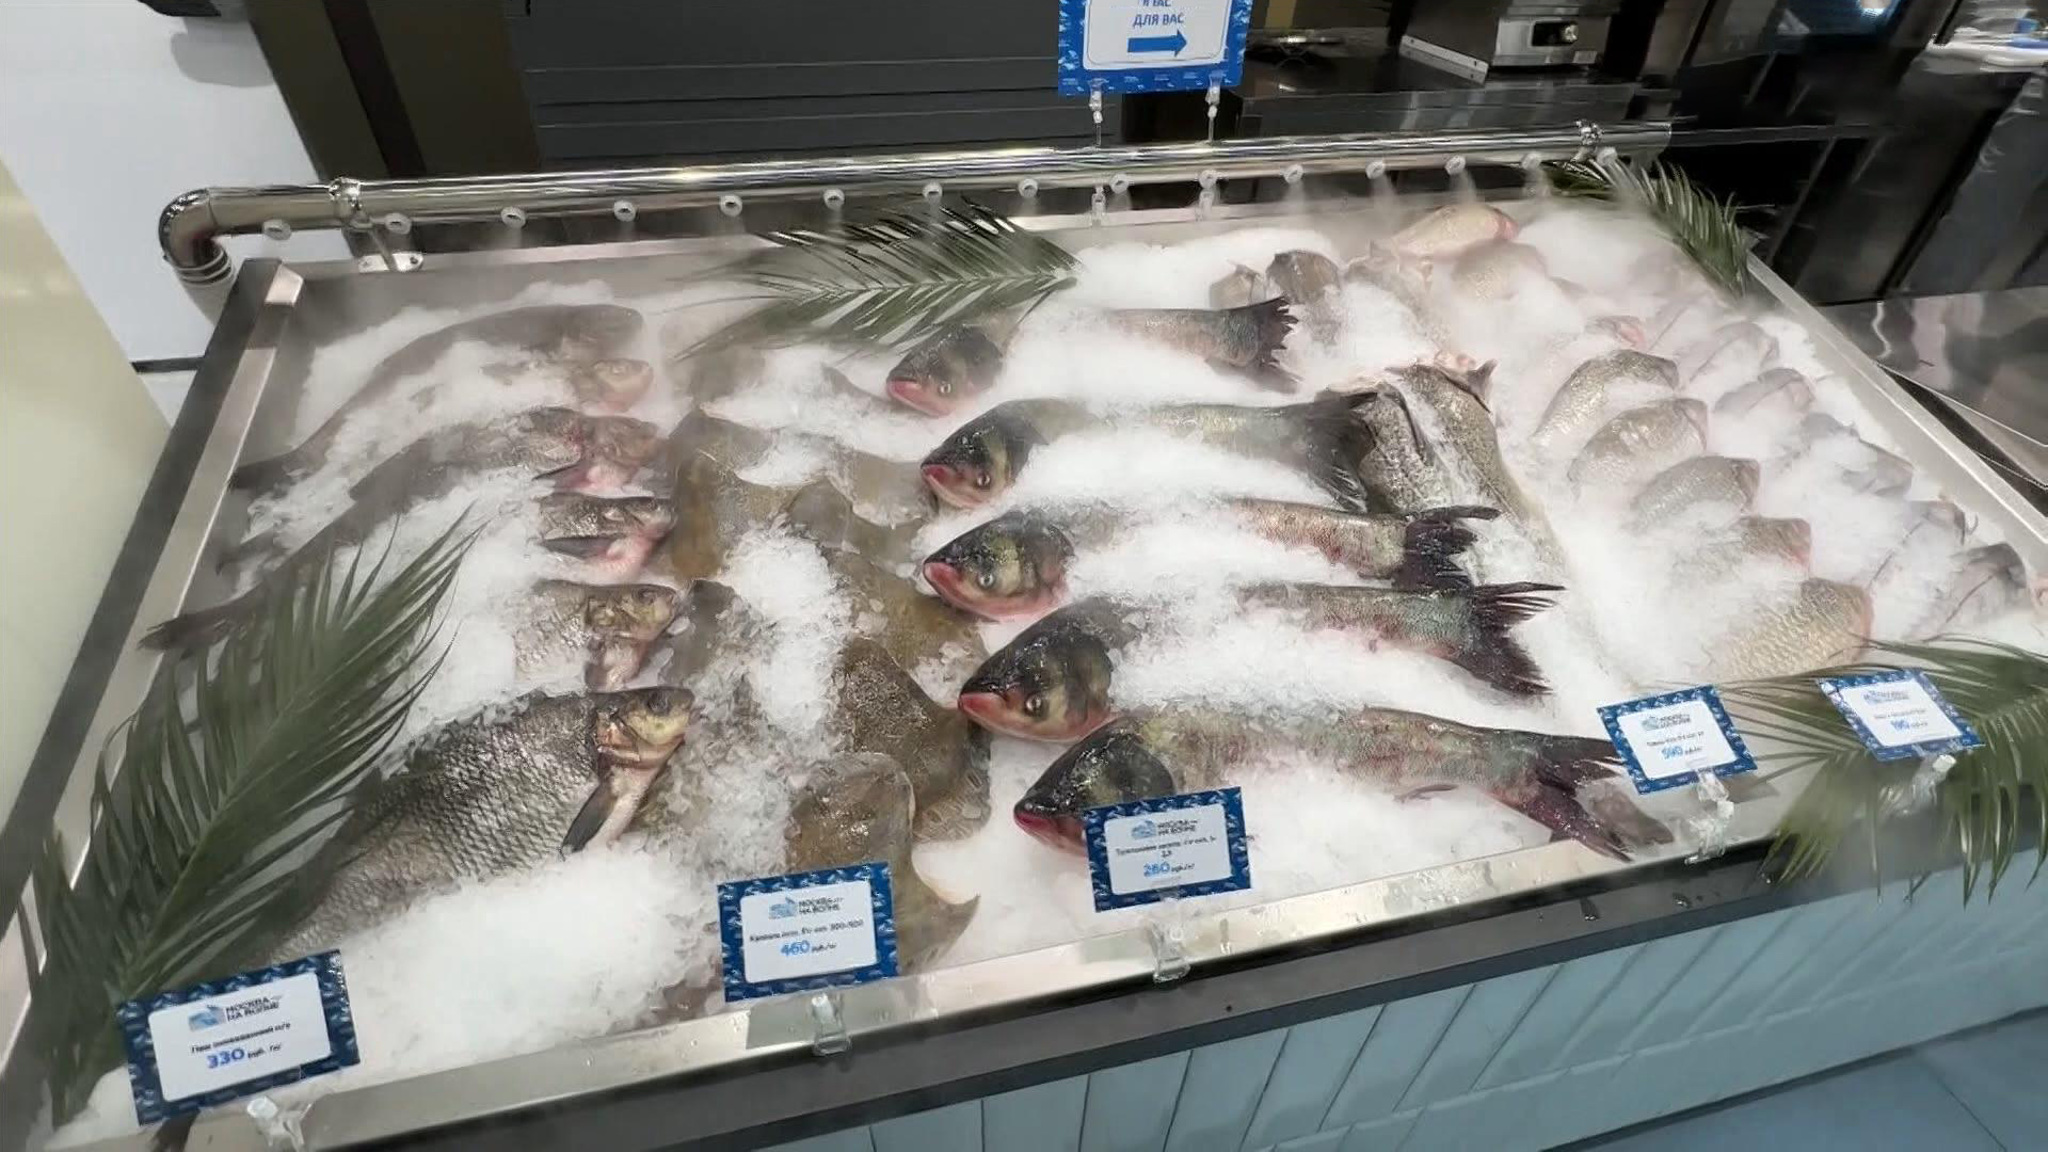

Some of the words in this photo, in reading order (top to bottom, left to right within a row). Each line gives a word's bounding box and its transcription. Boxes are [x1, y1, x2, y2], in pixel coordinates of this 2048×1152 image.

[1133, 14, 1159, 28] ДЛЯ
[1162, 12, 1184, 25] ВАС
[780, 940, 810, 956] 460
[226, 996, 271, 1012] МОСКВА
[227, 1010, 243, 1022] НА
[244, 1001, 280, 1018] ВОЛНЕ
[206, 1048, 246, 1069] 330
